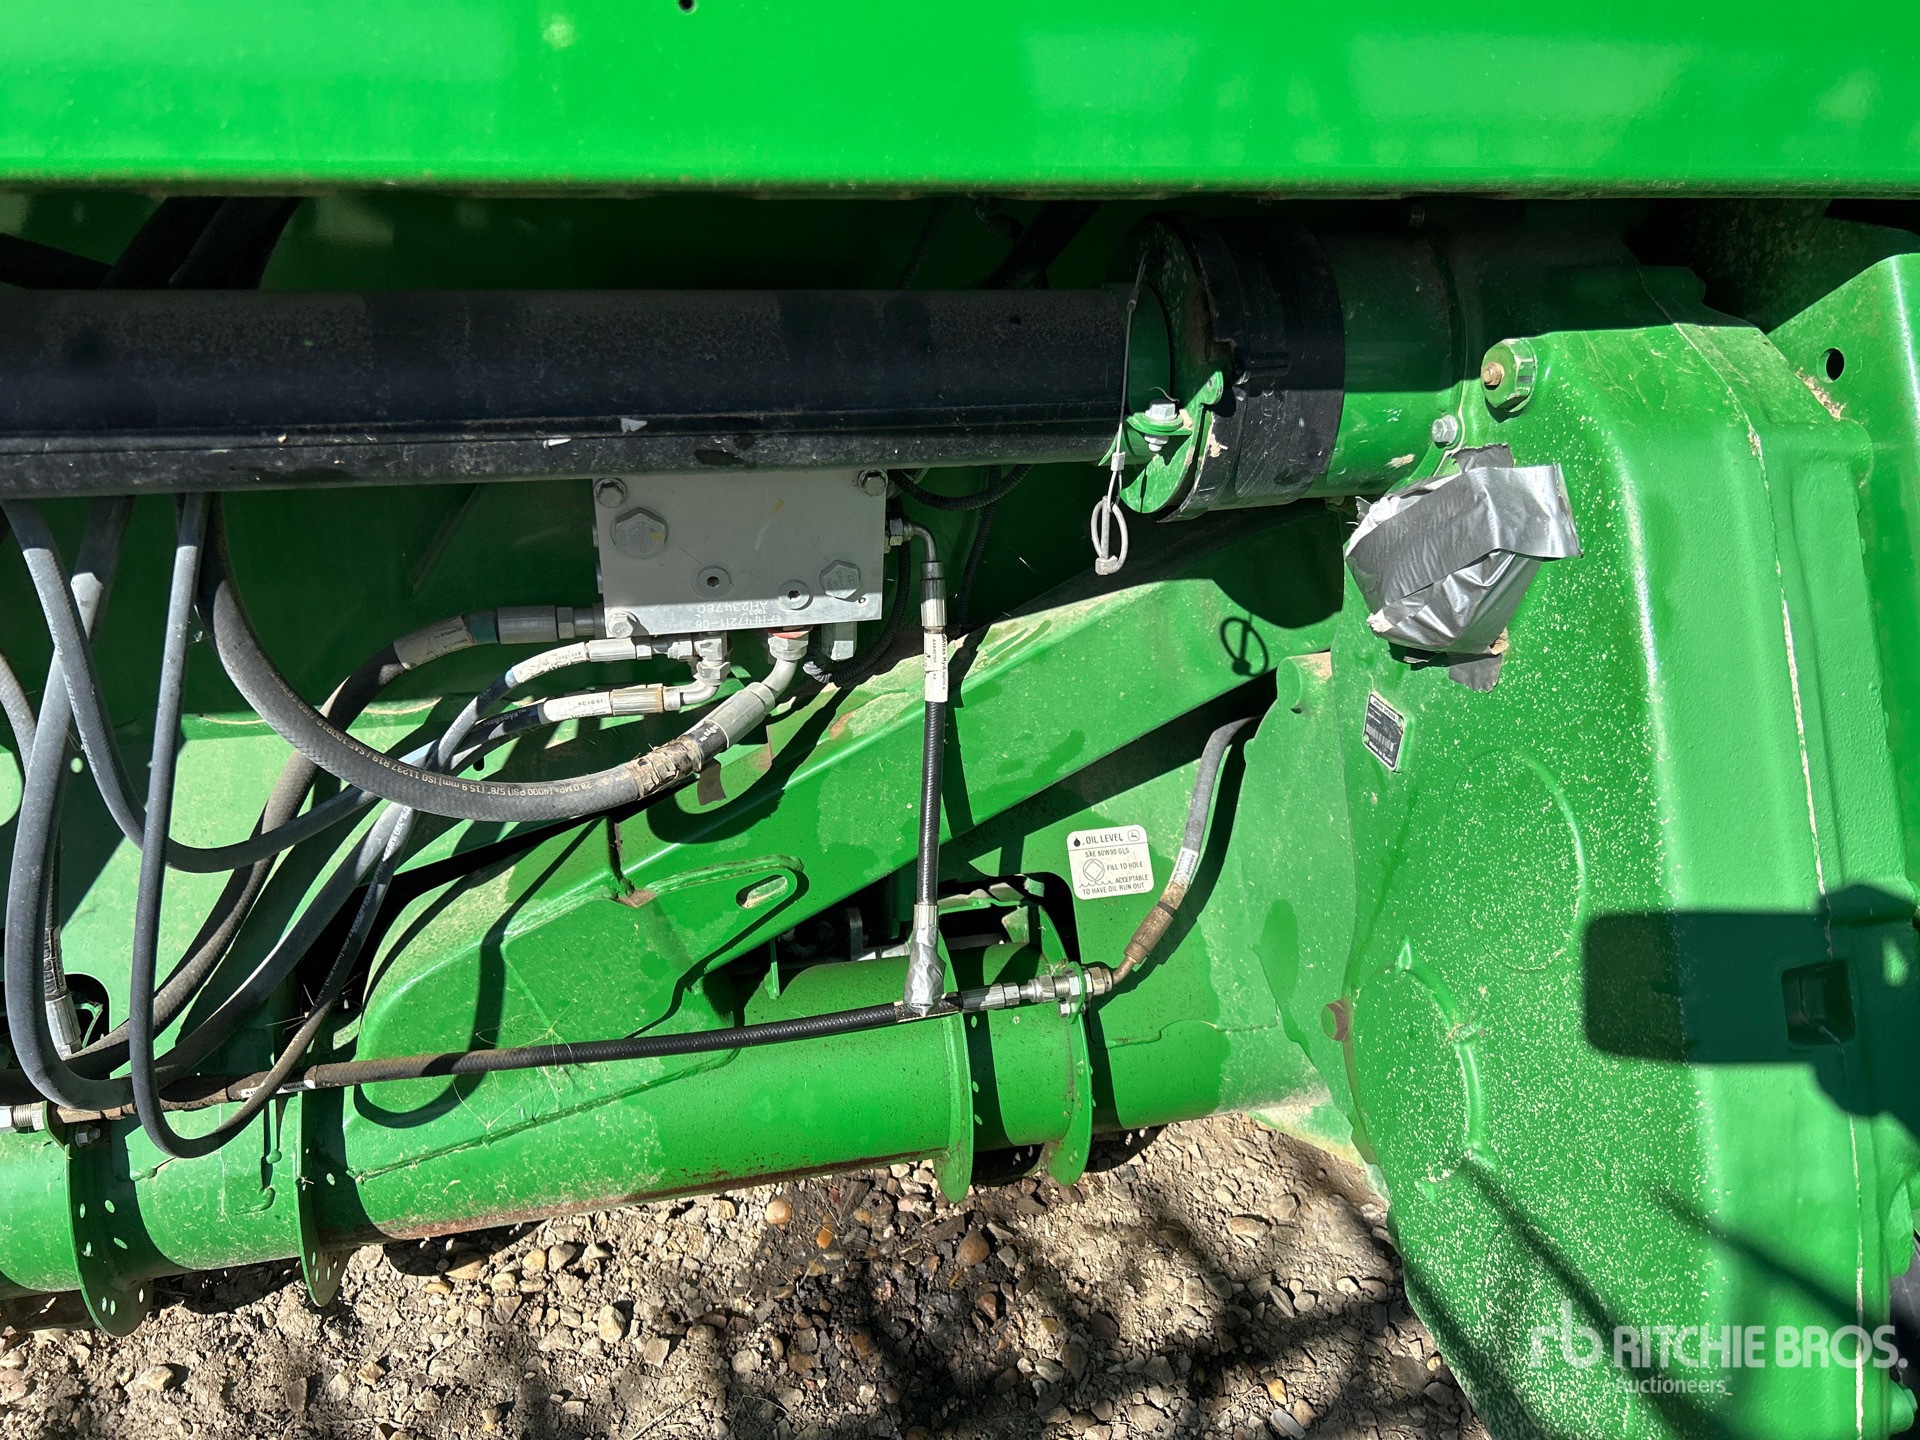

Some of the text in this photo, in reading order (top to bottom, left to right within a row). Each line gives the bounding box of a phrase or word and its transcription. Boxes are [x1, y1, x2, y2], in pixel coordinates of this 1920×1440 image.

[697, 600, 768, 614] AH234780
[348, 740, 365, 755] SAE
[372, 754, 391, 768] R19
[391, 764, 420, 779] 11237
[422, 774, 437, 784] ISO
[1086, 833, 1124, 845] OIL LEVEL
[1085, 850, 1096, 858] SAE
[1128, 861, 1143, 869] HOLE
[1115, 874, 1149, 883] ACCEPTABLE
[1092, 886, 1107, 894] HAVE
